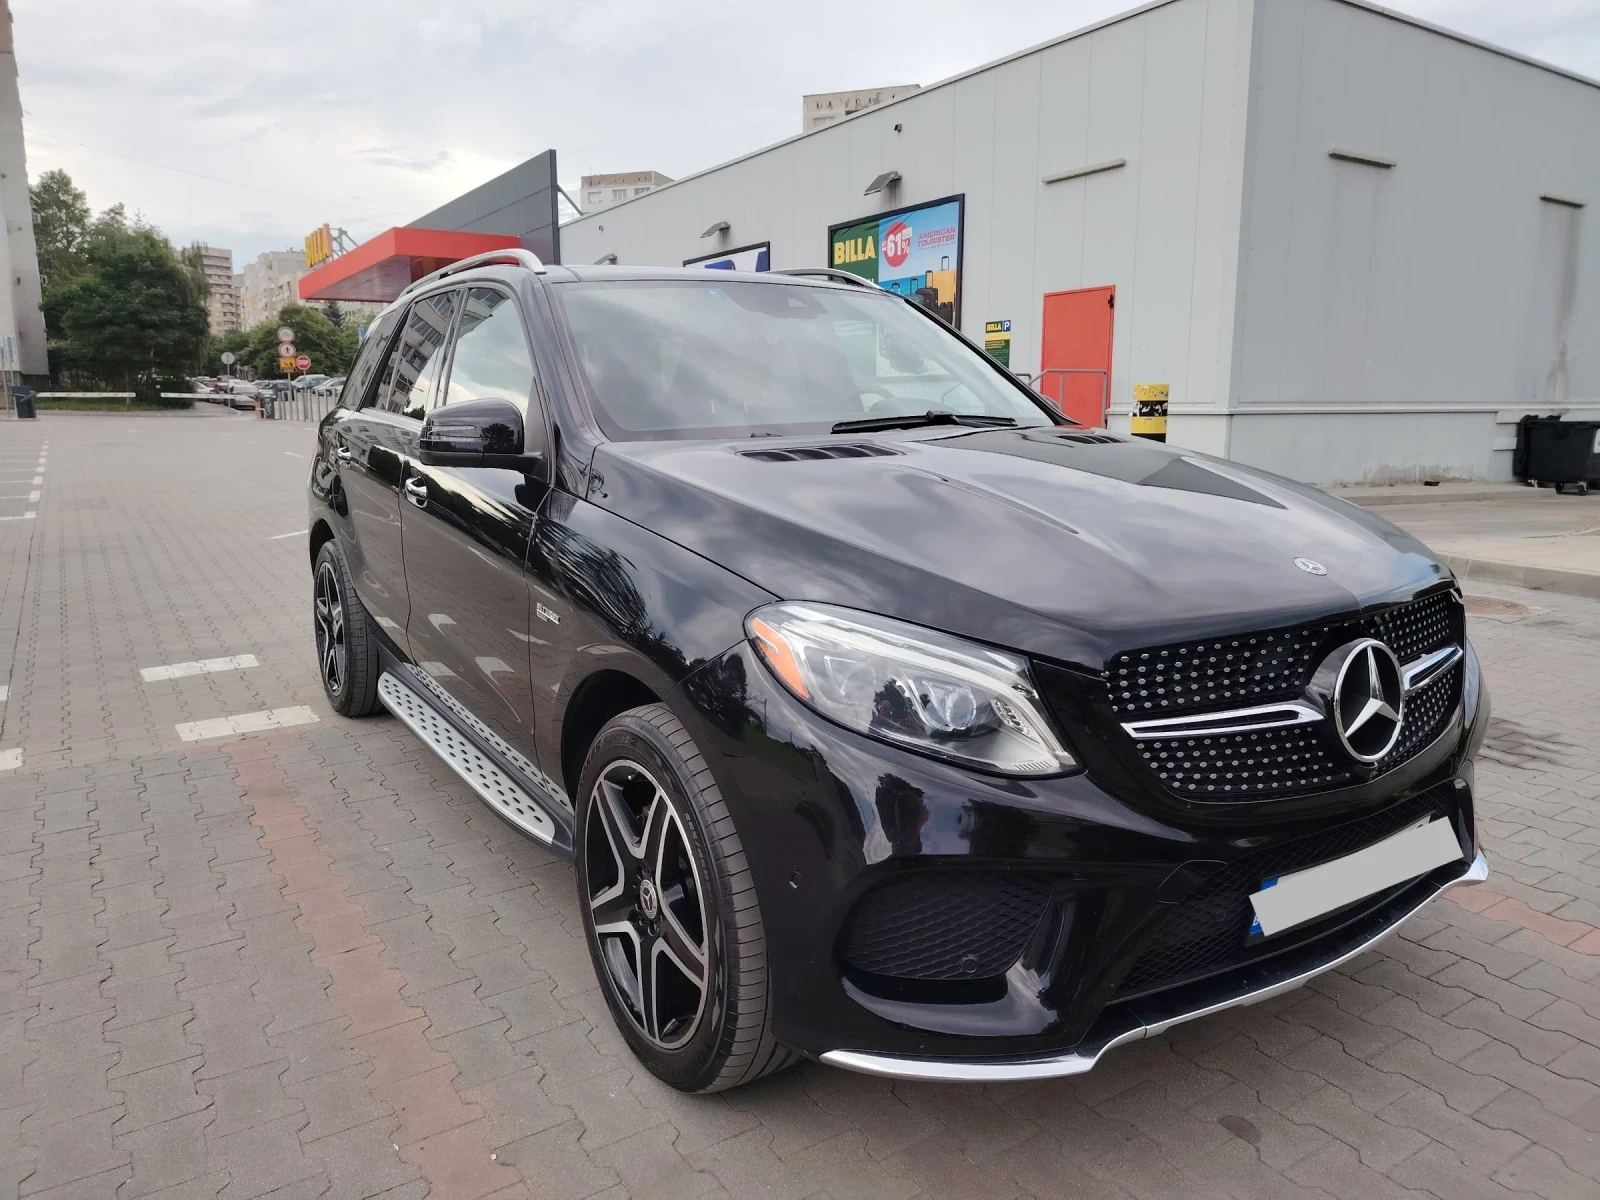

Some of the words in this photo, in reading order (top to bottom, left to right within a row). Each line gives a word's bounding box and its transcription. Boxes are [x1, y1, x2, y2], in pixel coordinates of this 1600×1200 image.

[918, 226, 957, 241] AMERICAN
[918, 234, 956, 248] TOURISTER
[834, 235, 877, 265] BILLA
[986, 322, 1002, 332] BILLA
